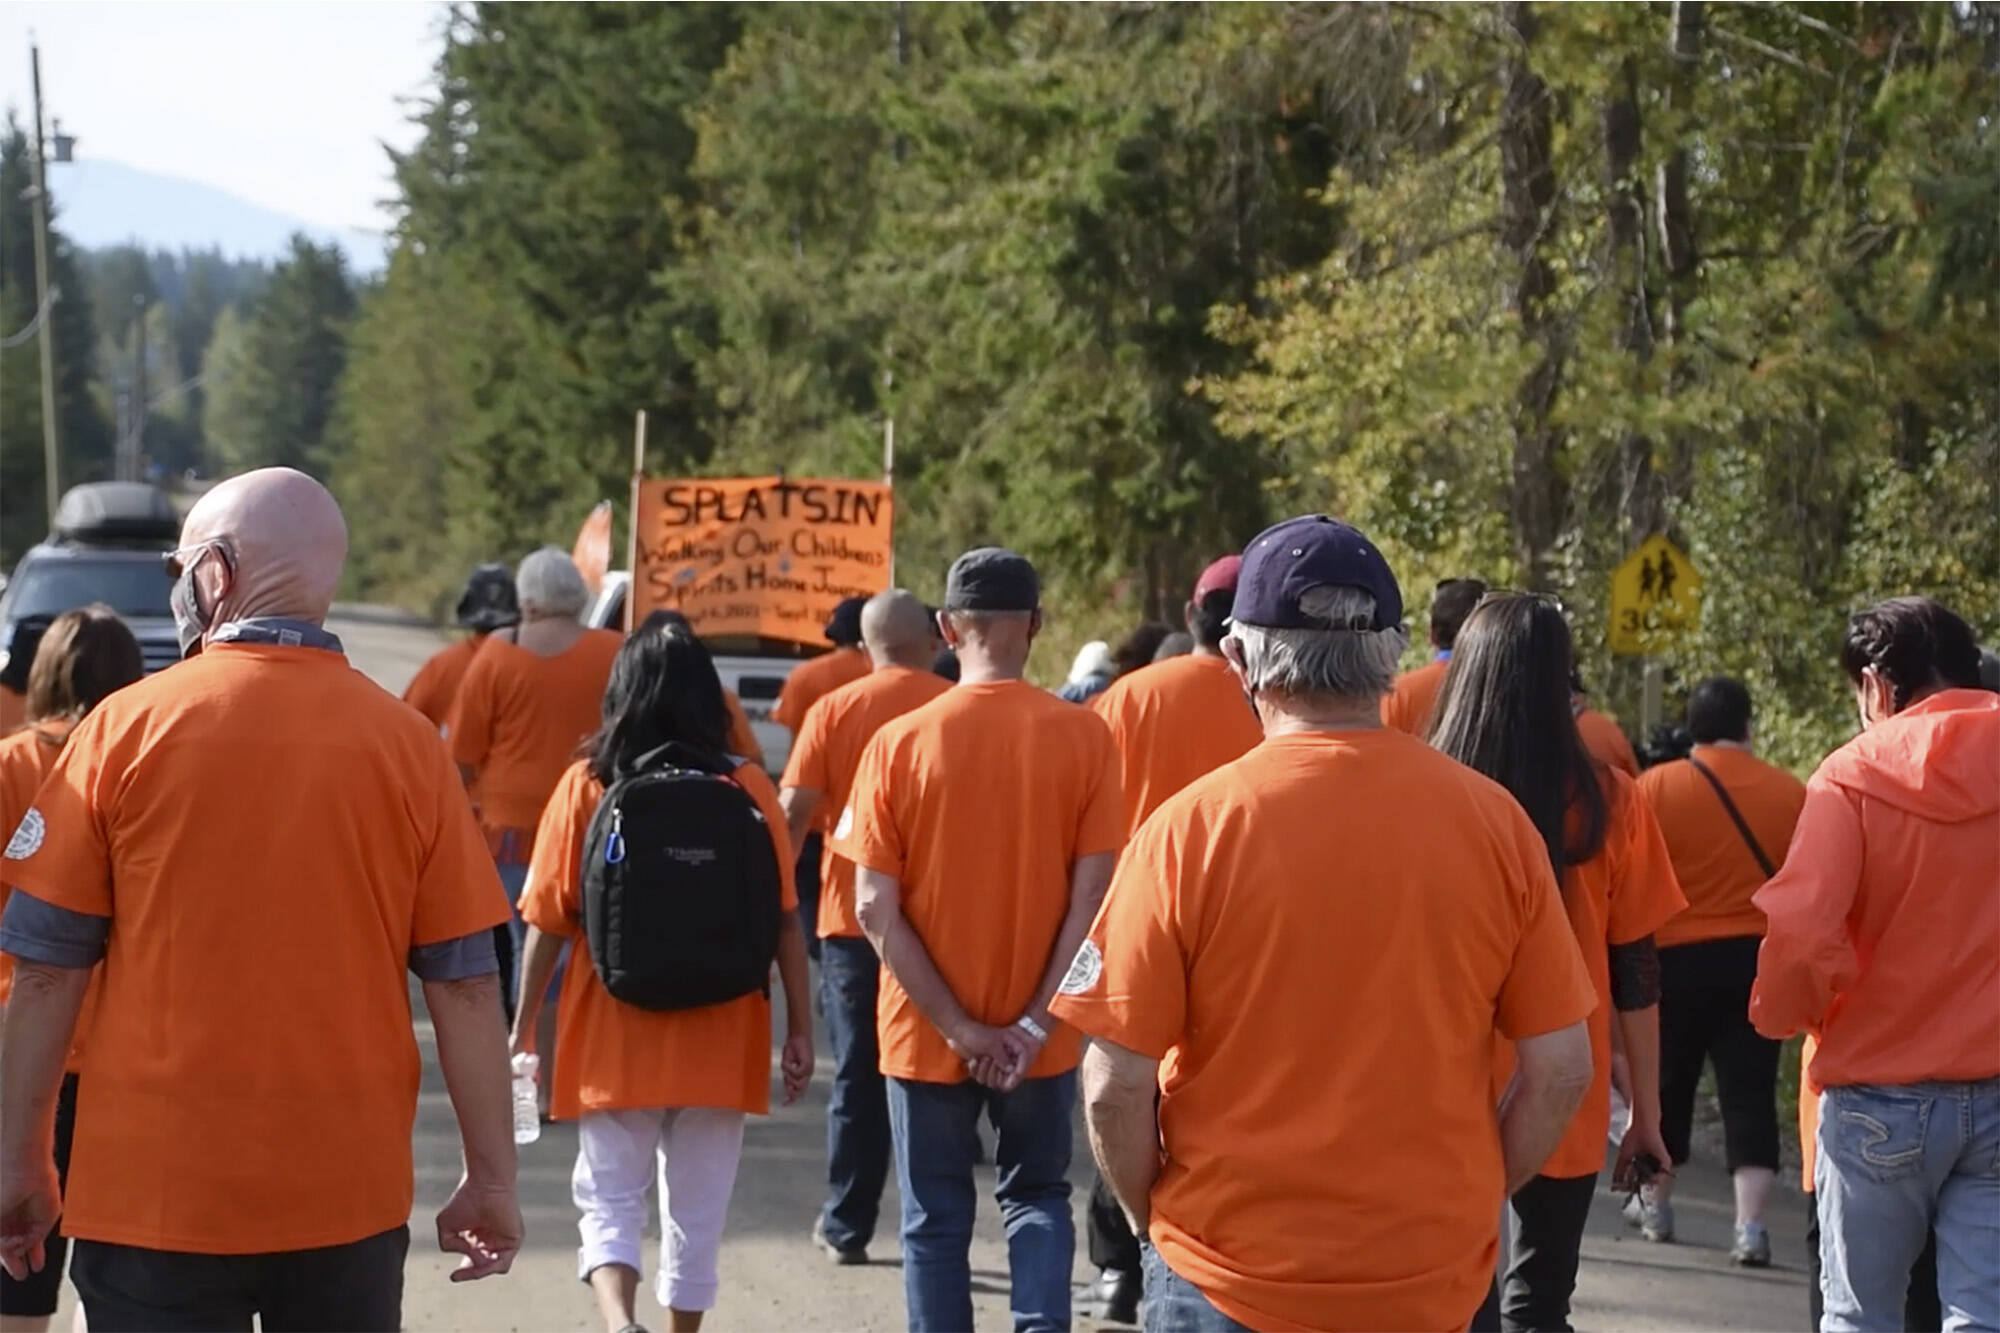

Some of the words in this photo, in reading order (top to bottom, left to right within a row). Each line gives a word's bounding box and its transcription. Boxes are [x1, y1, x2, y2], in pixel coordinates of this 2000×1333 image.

[664, 483, 881, 527] SPLATSIN
[733, 529, 783, 557] Our
[746, 562, 806, 593] Home
